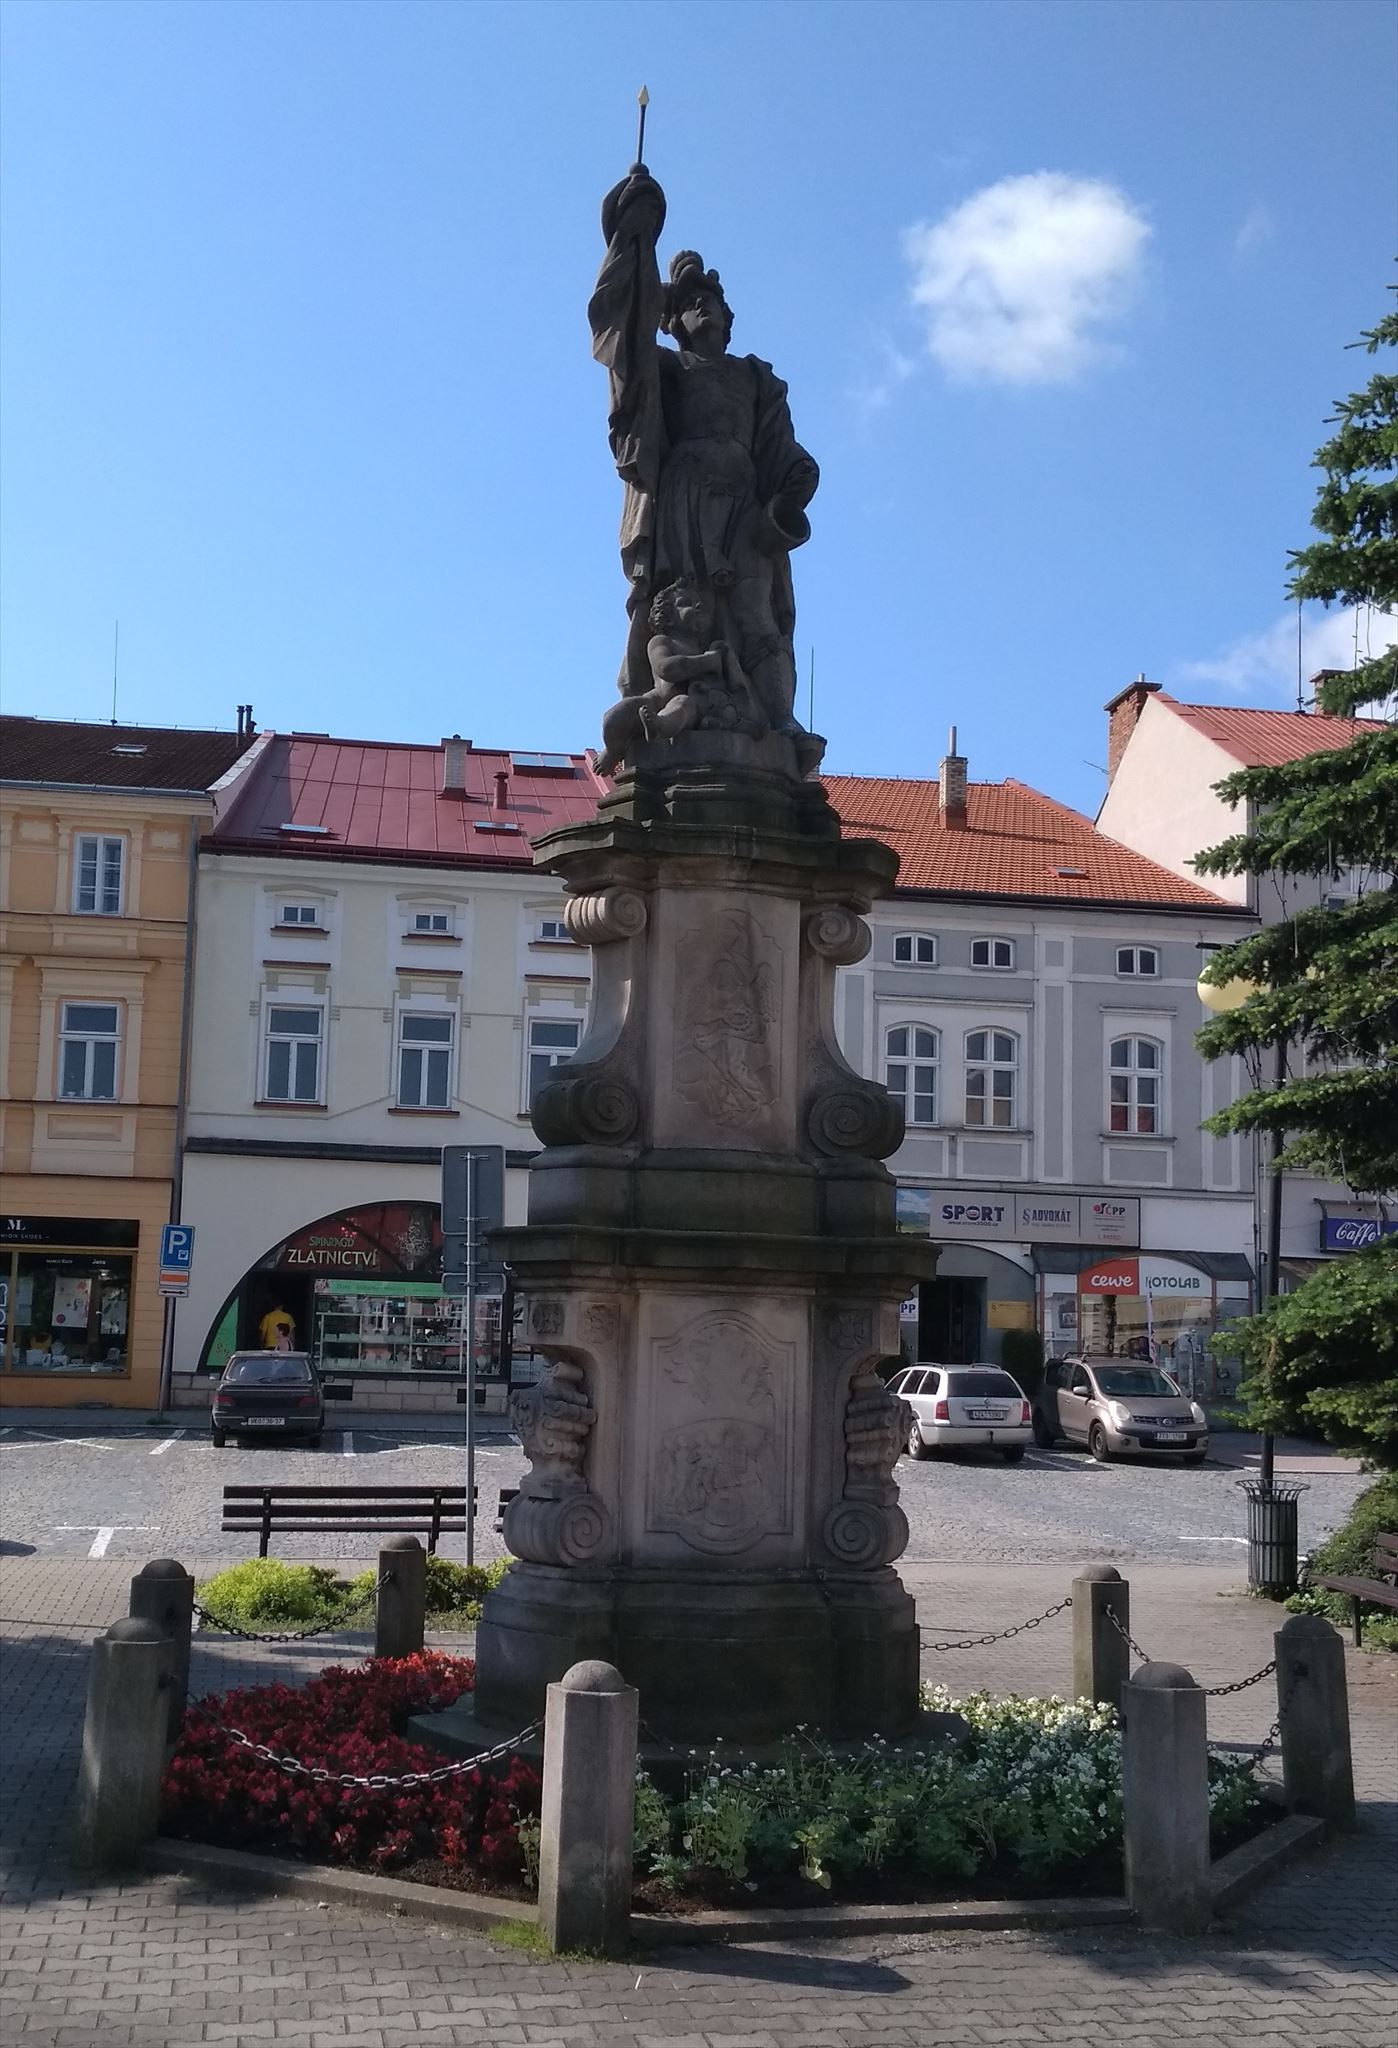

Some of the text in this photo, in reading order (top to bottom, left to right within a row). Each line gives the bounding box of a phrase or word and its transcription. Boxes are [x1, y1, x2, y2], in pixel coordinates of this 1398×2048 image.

[942, 1204, 1004, 1221] SPORT
[1032, 1208, 1071, 1222] ADVOKÁT
[168, 1230, 187, 1254] P
[287, 1248, 378, 1266] ZLATNICTVÍ
[1091, 1275, 1134, 1287] cewe
[900, 1303, 917, 1313] PP
